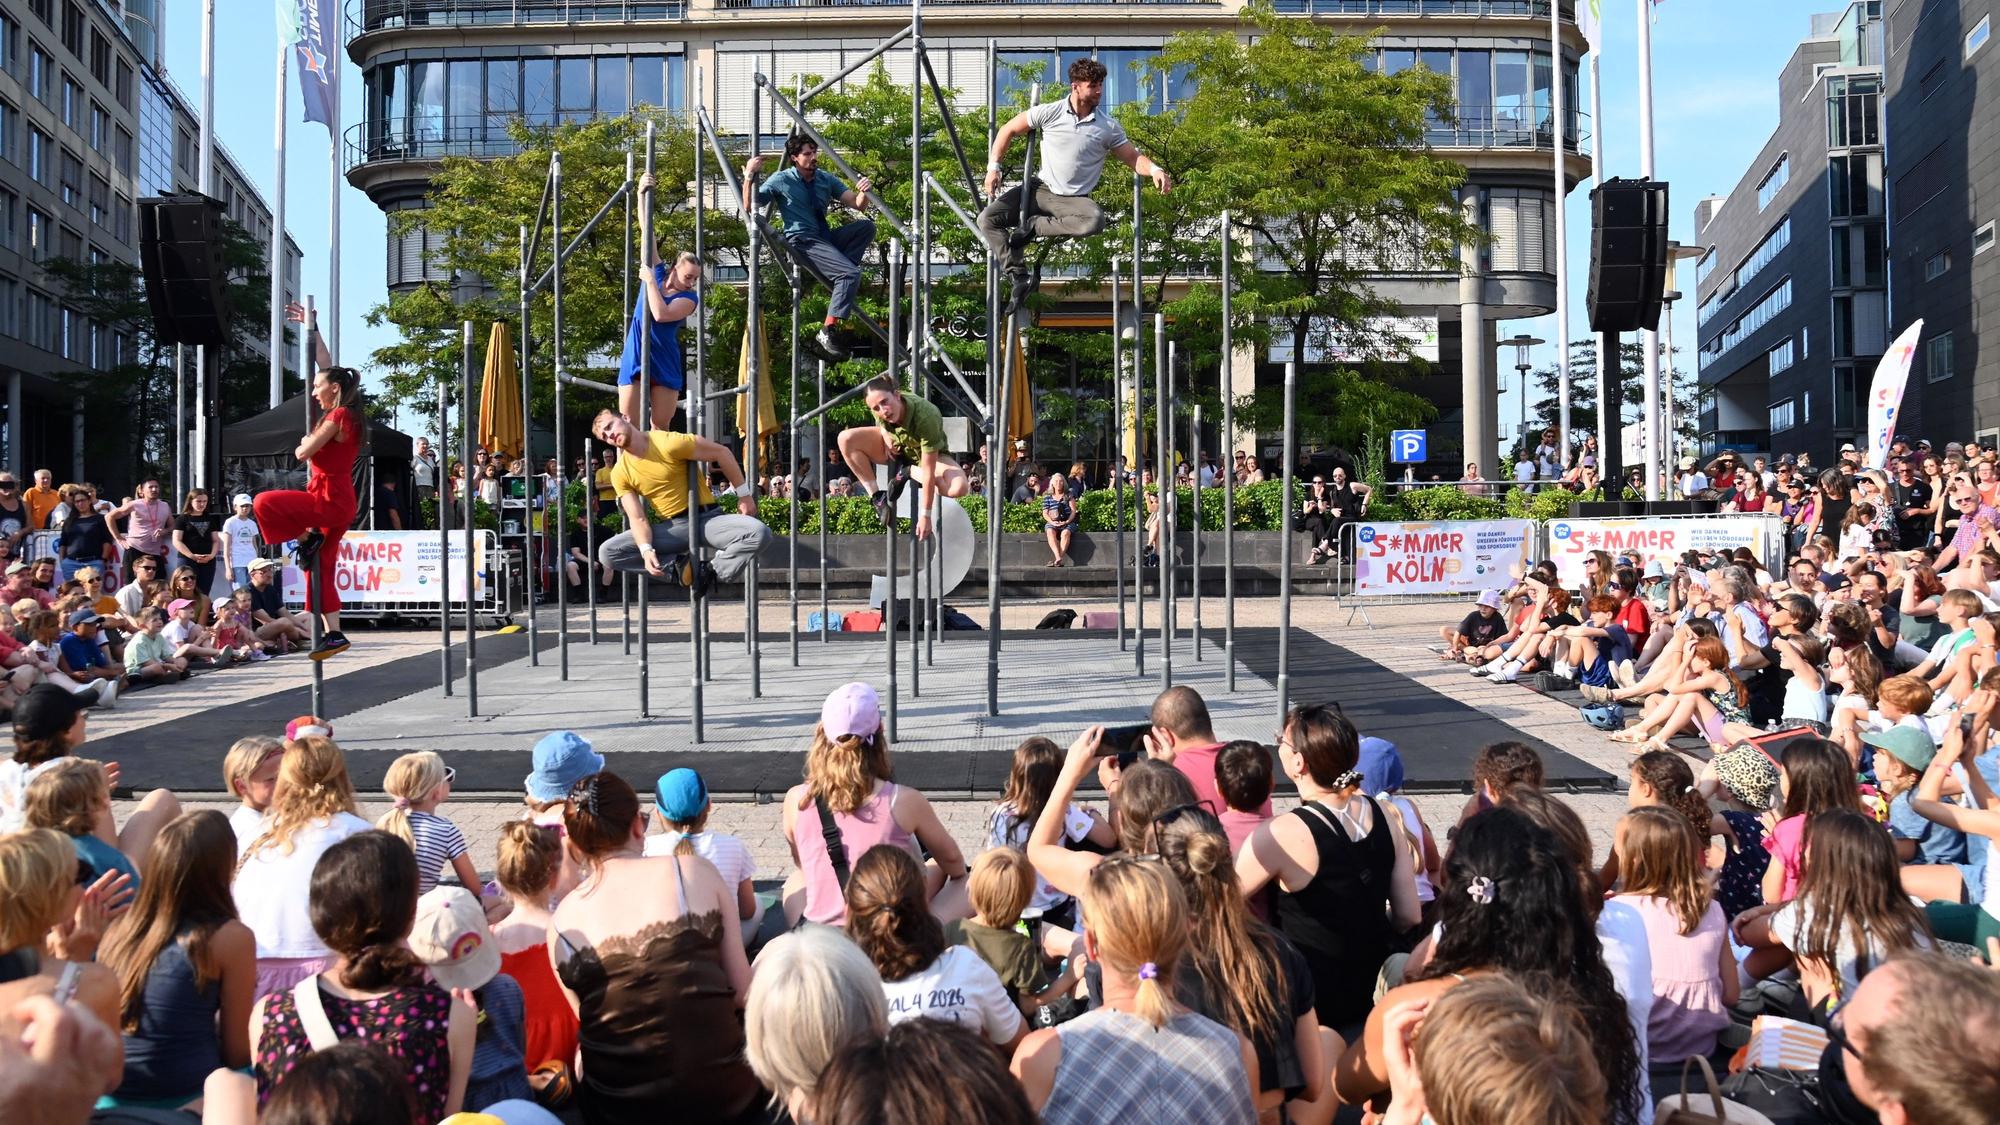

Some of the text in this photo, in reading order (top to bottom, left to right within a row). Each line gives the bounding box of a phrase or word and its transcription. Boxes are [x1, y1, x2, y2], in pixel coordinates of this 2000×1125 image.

[1403, 439, 1420, 460] P
[336, 563, 383, 592] ÖLN
[1386, 554, 1447, 584] KÖLN
[912, 993, 922, 1010] 4
[928, 987, 966, 1009] 2026
